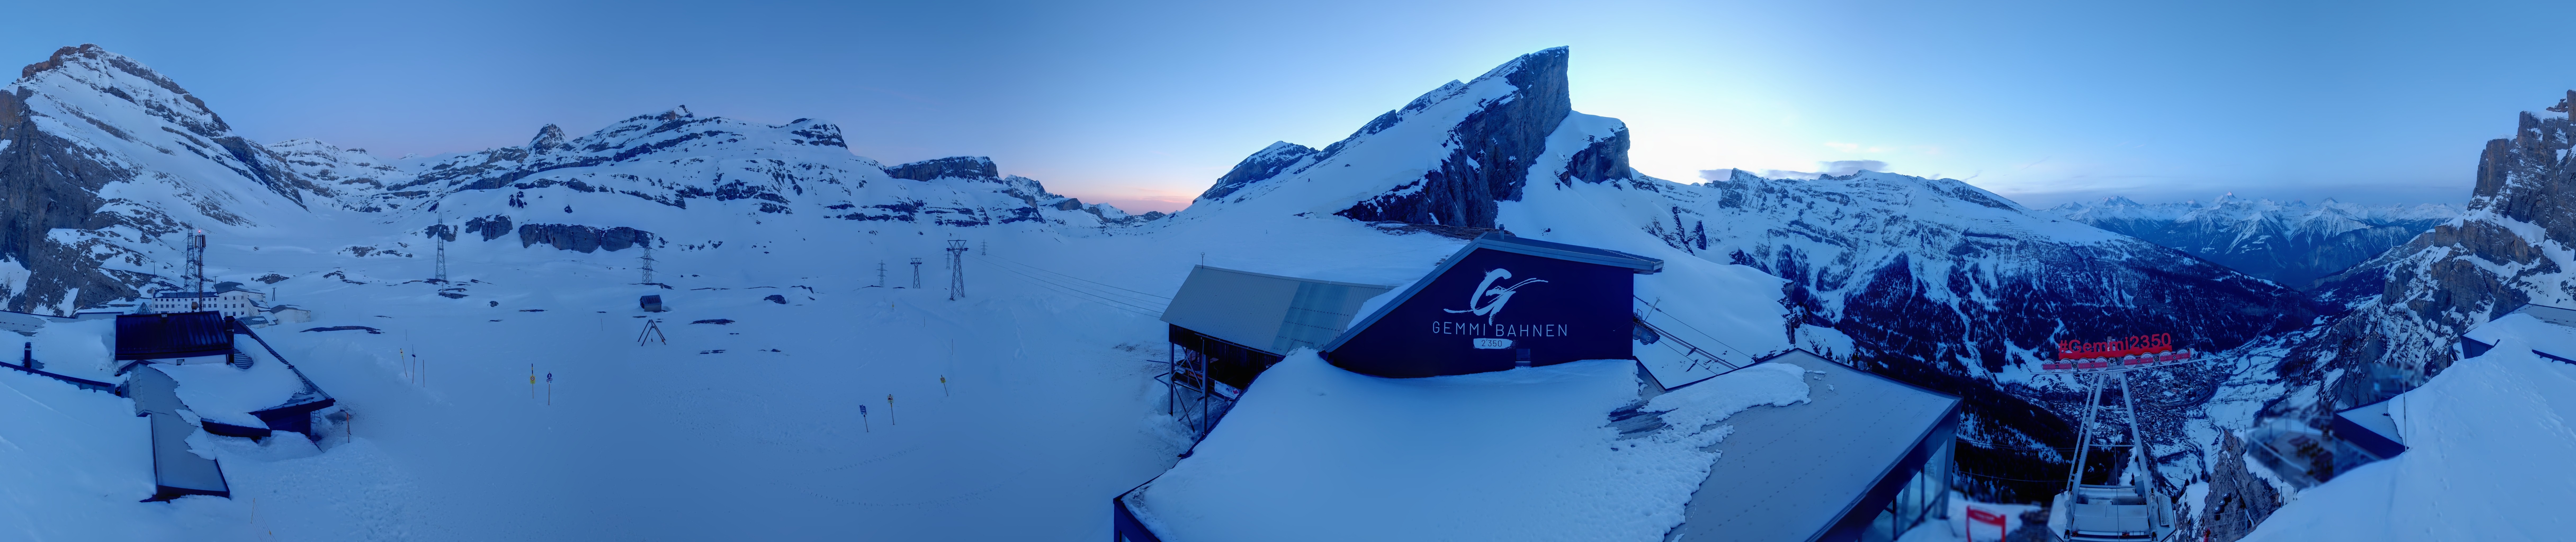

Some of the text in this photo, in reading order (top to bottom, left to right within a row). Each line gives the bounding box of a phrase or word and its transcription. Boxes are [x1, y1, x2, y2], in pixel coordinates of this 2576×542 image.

[1433, 321, 1567, 337] GEMMI BAHNEN
[1481, 339, 1502, 347] 2'350
[2058, 333, 2171, 354] #Gemmi2350
